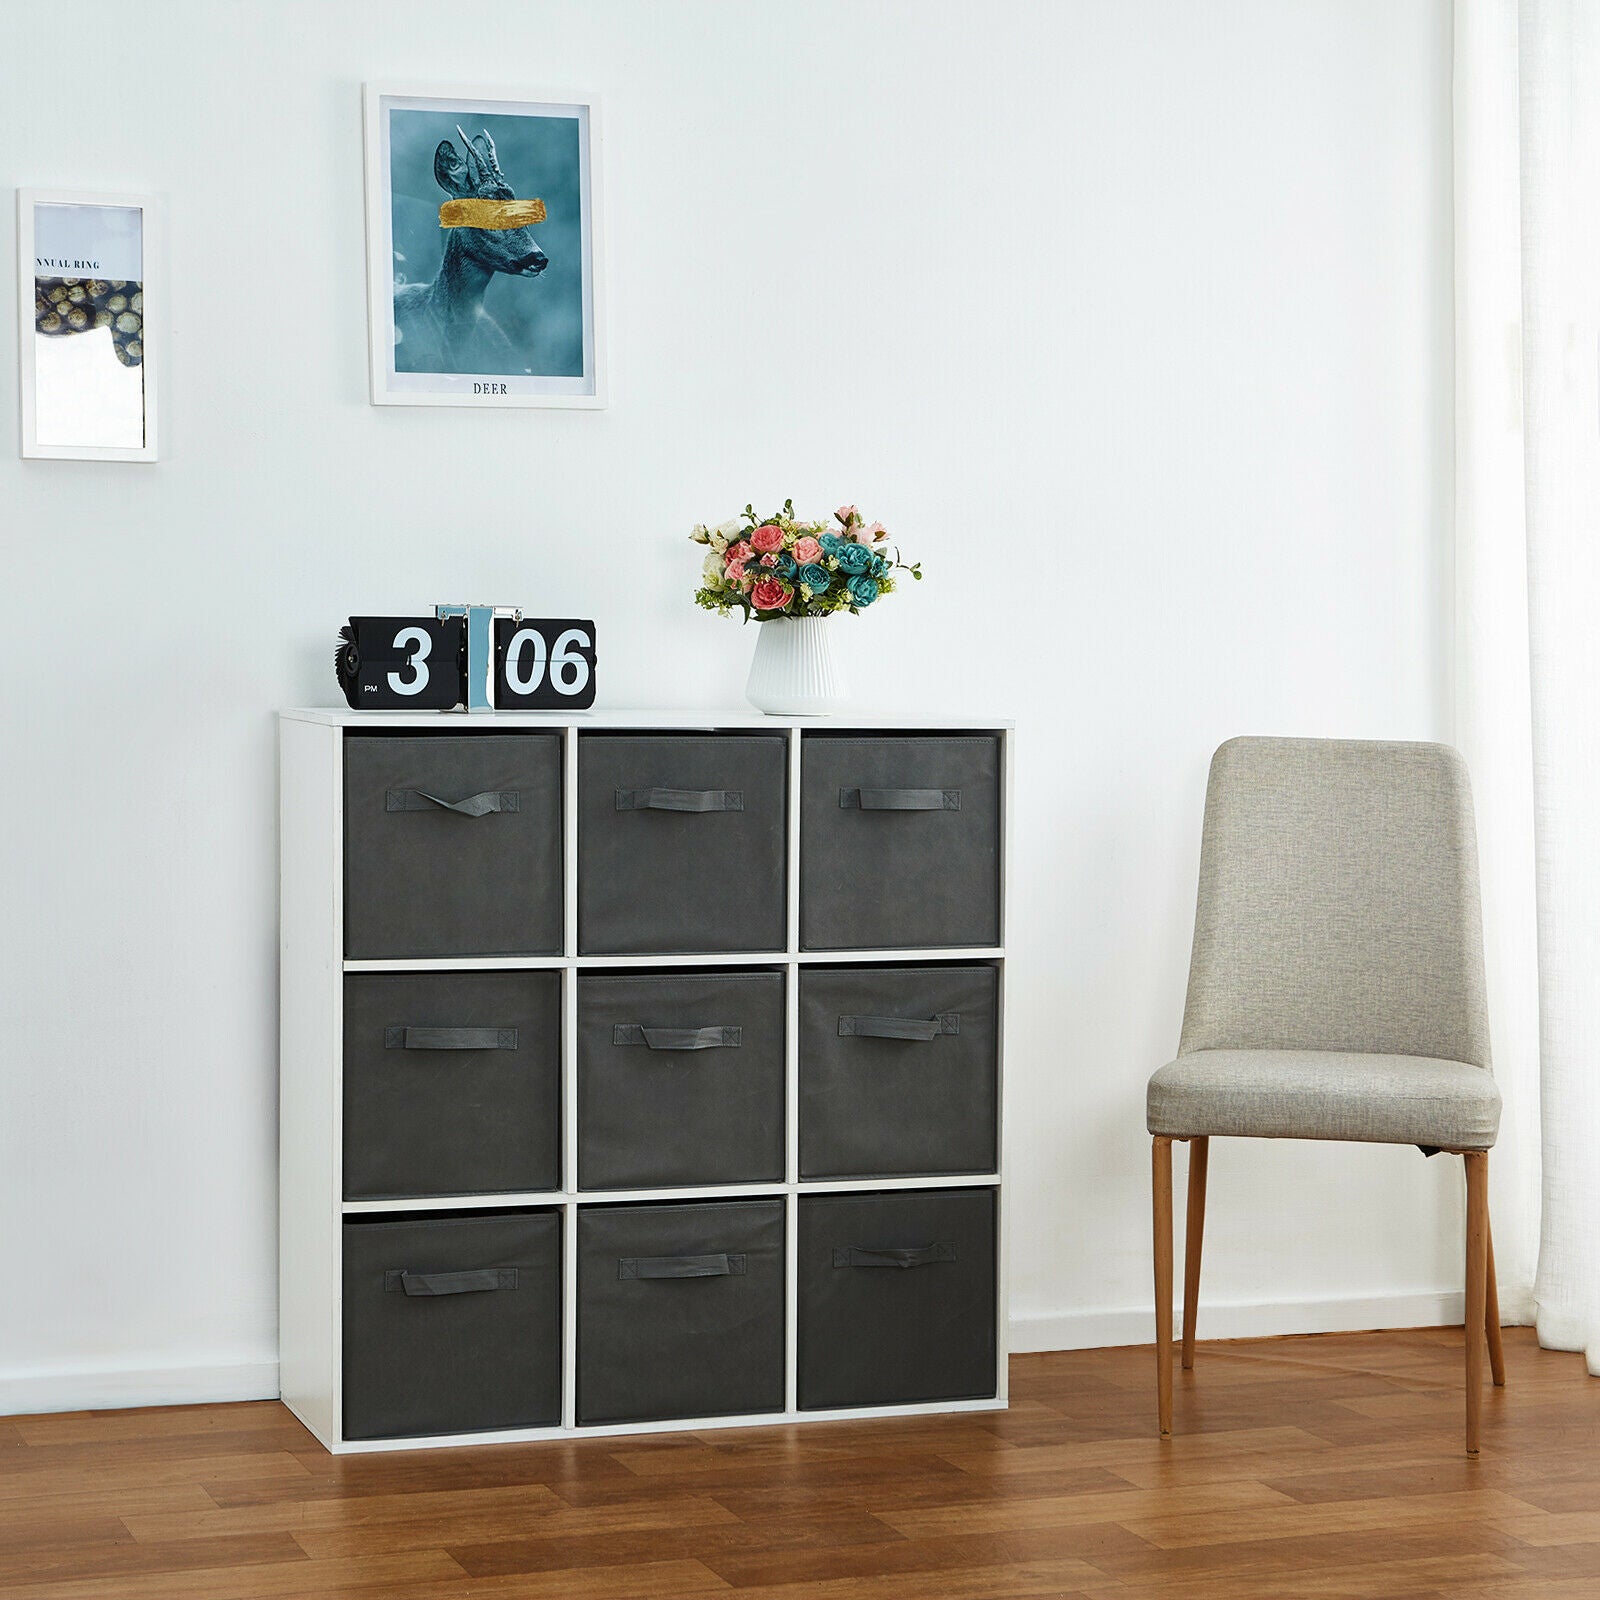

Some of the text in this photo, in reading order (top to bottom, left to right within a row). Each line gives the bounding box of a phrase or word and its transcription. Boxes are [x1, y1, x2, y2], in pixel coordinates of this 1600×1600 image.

[74, 260, 100, 270] RING
[473, 382, 508, 395] DEER
[386, 626, 592, 696] 3 06
[364, 685, 378, 693] PM
